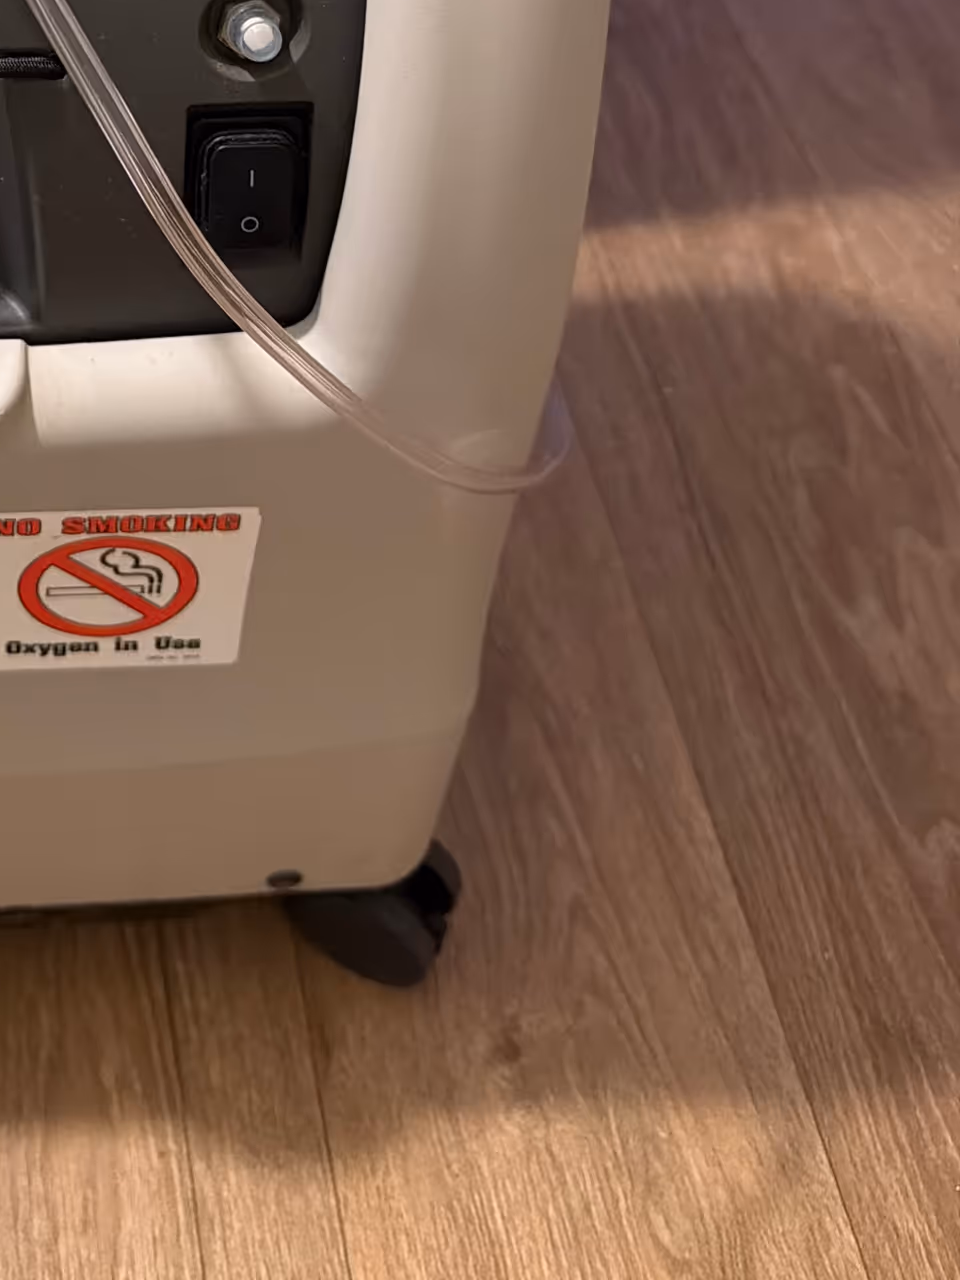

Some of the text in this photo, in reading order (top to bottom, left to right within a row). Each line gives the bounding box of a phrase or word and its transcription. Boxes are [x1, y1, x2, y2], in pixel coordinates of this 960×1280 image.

[61, 514, 241, 535] SMOKING
[5, 635, 202, 657] Oxygen in Use
